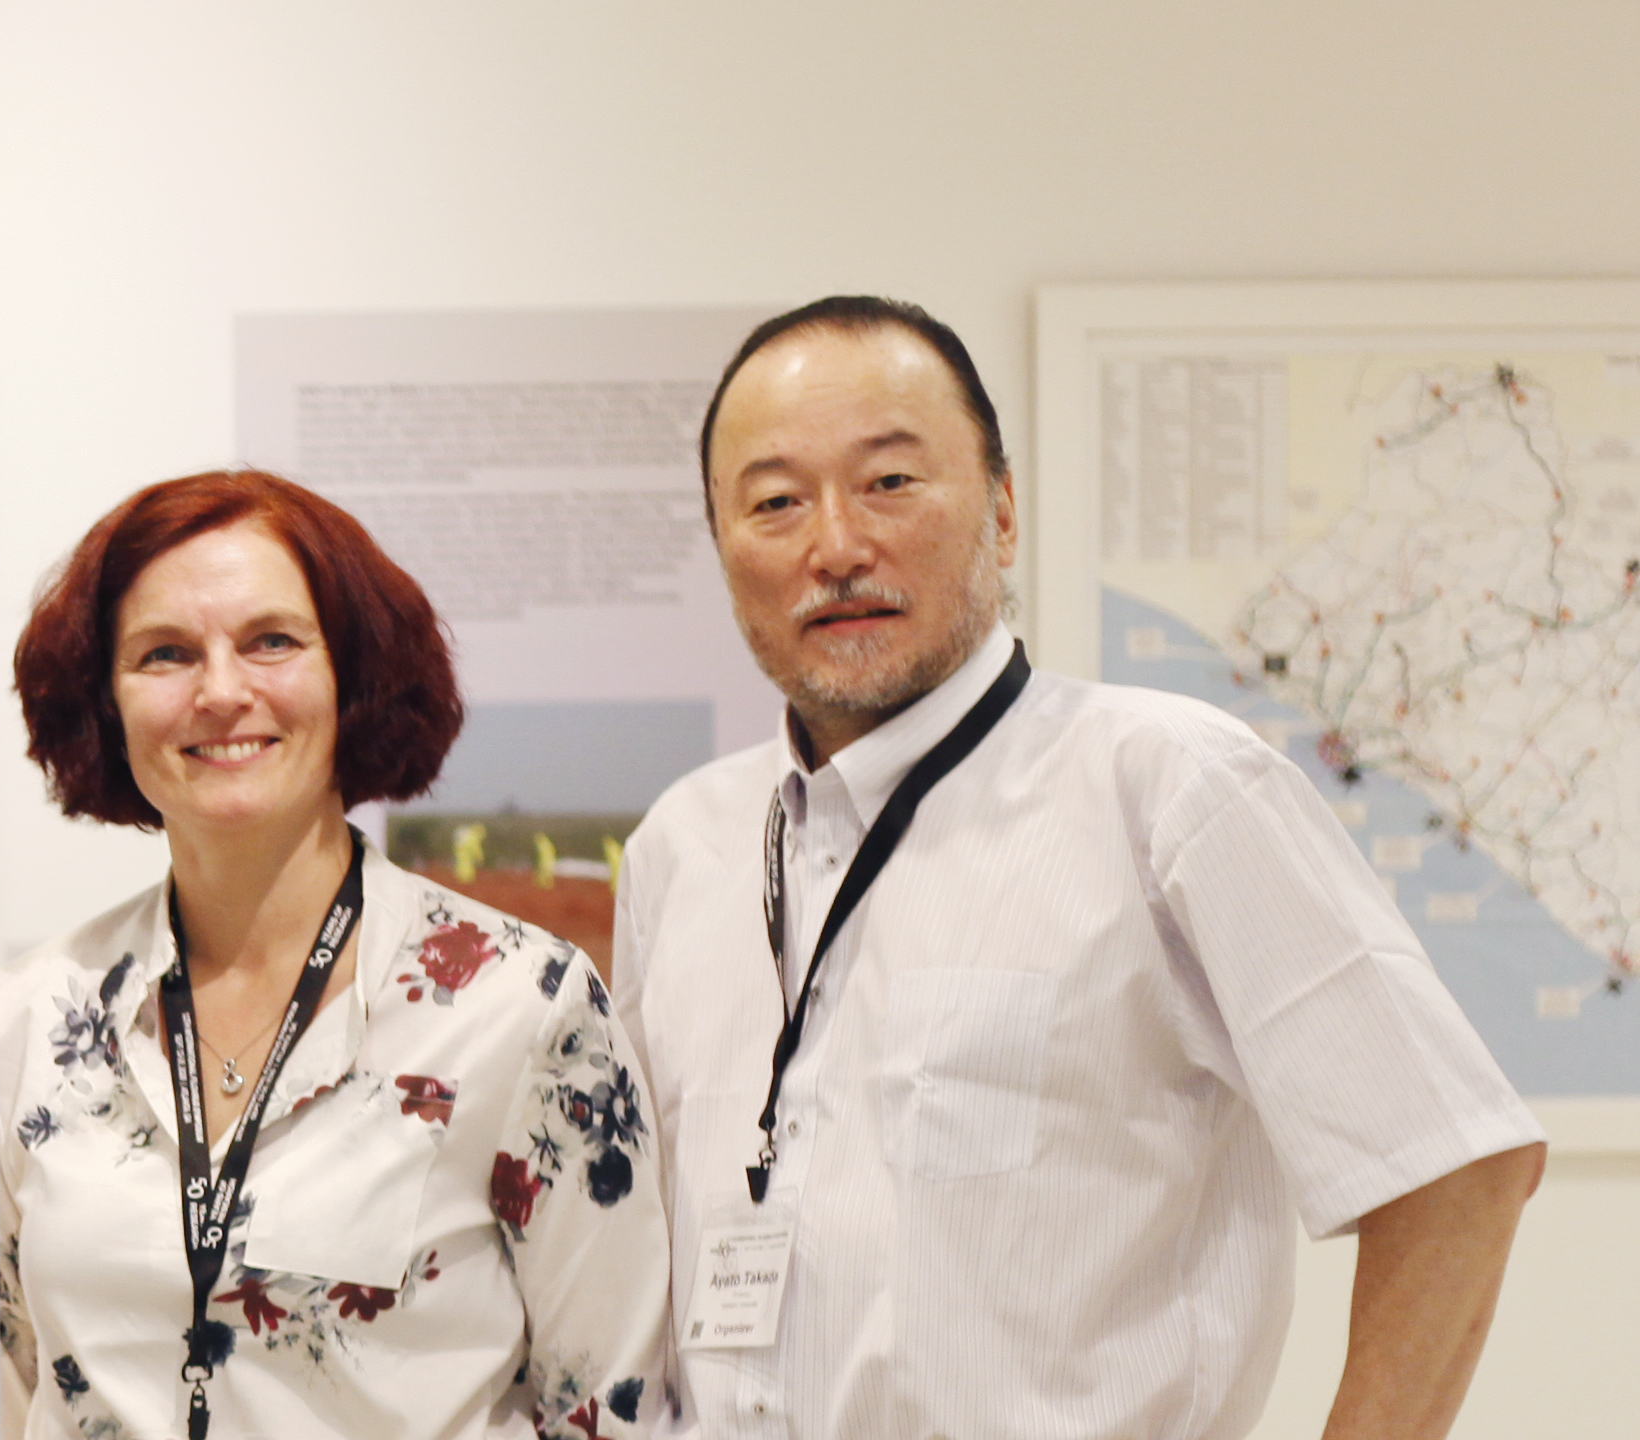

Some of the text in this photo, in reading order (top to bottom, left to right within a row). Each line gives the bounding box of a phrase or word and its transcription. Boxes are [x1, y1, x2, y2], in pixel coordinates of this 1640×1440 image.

[310, 948, 333, 969] 50
[186, 1177, 207, 1199] 50
[202, 1227, 223, 1249] 50
